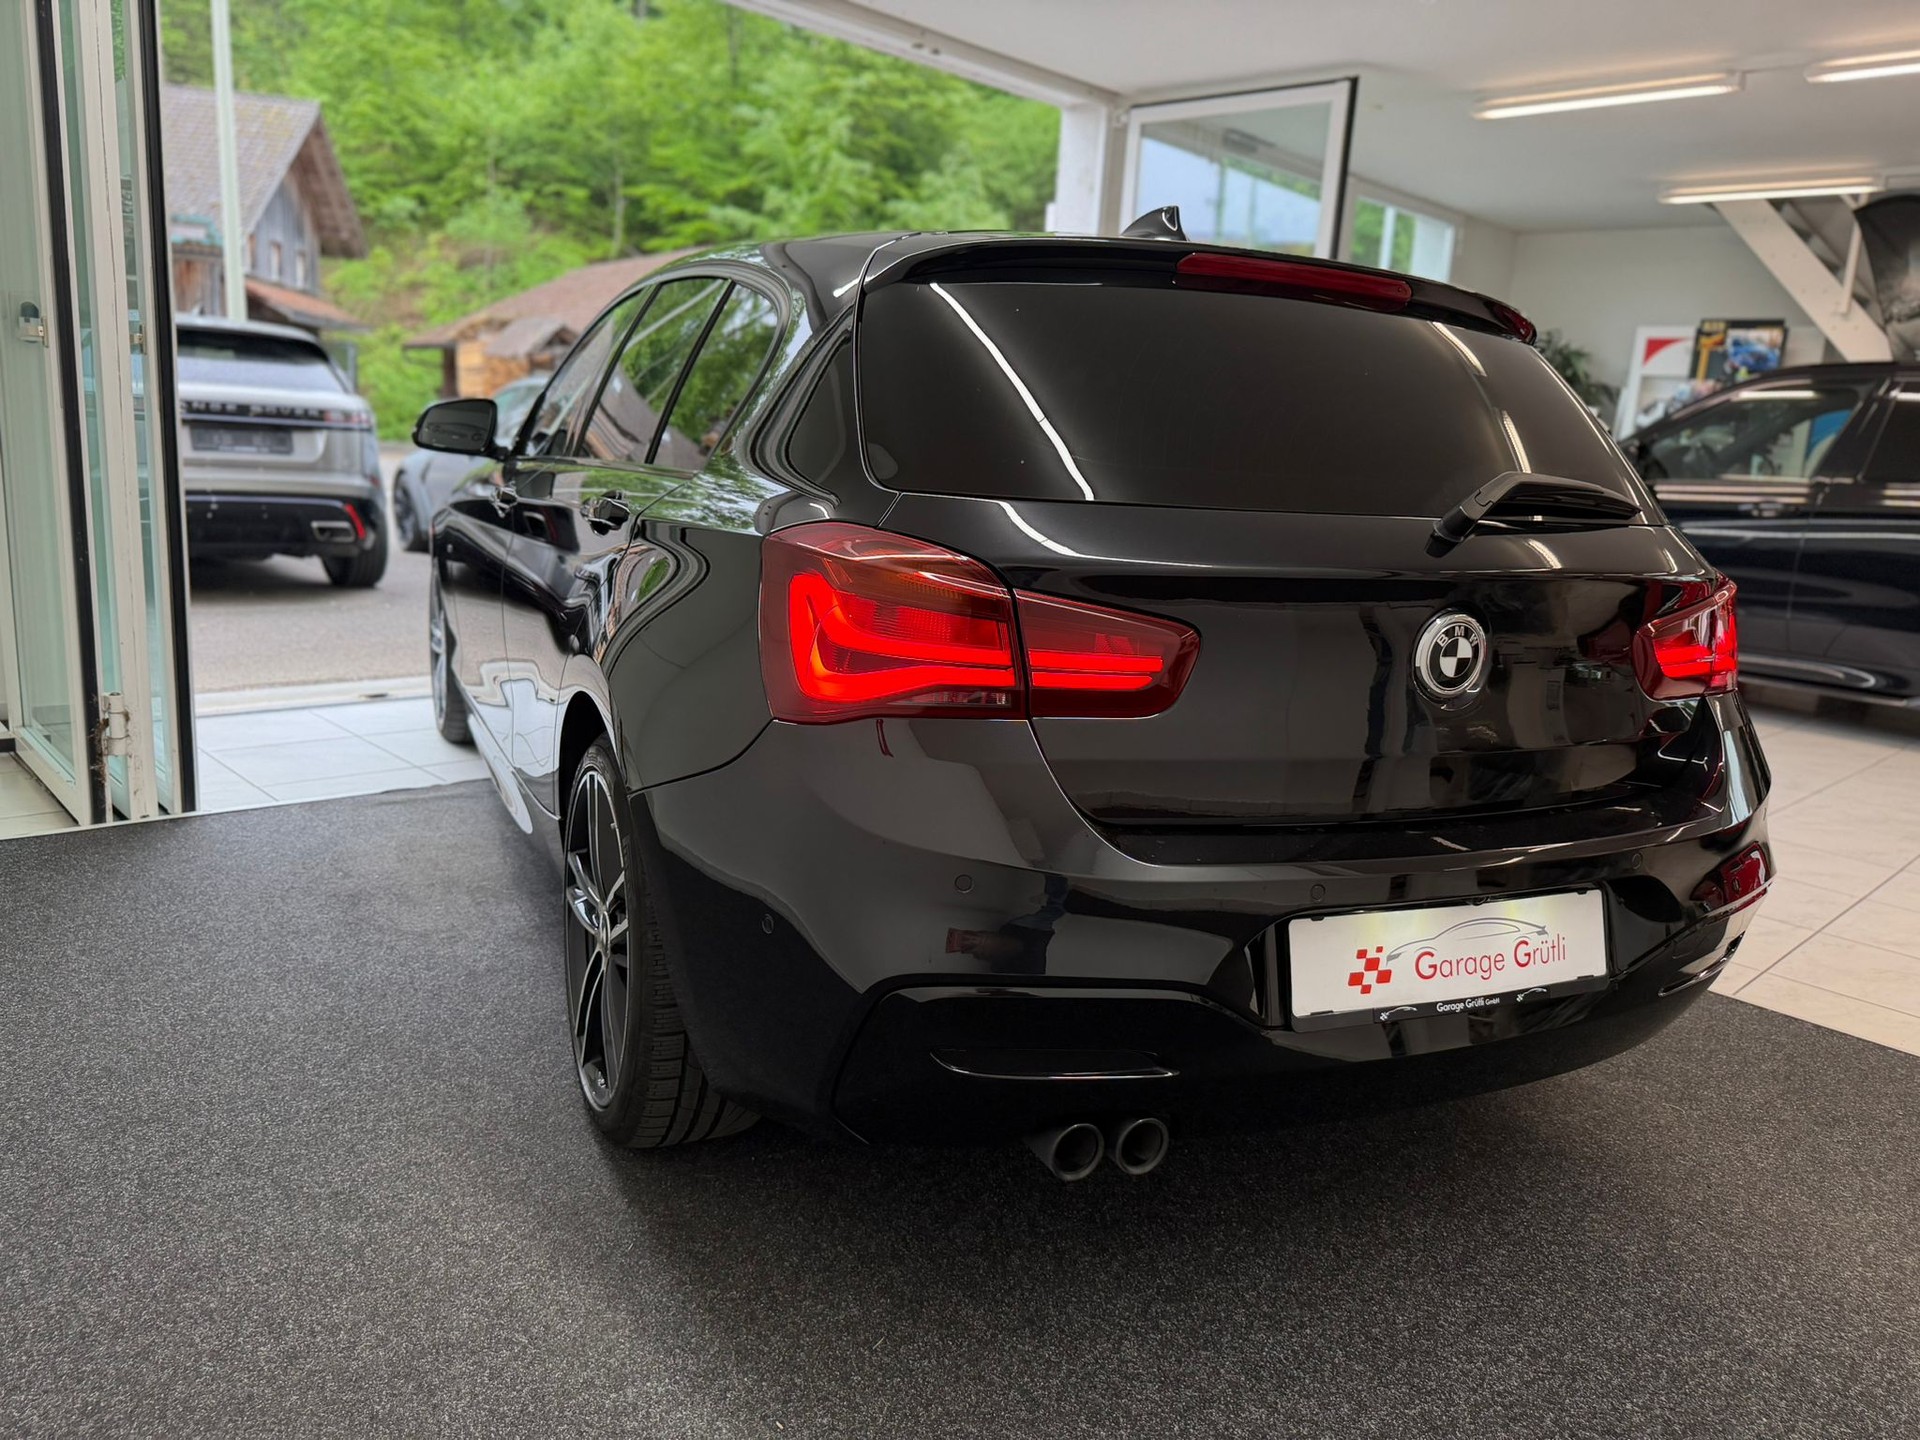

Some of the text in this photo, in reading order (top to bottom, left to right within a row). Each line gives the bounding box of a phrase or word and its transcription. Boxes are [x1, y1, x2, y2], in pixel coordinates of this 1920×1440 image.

[1436, 626, 1478, 648] BMW
[1414, 933, 1567, 981] Garage Grütli
[1436, 1002, 1465, 1013] Garage
[1465, 997, 1485, 1008] Grütli
